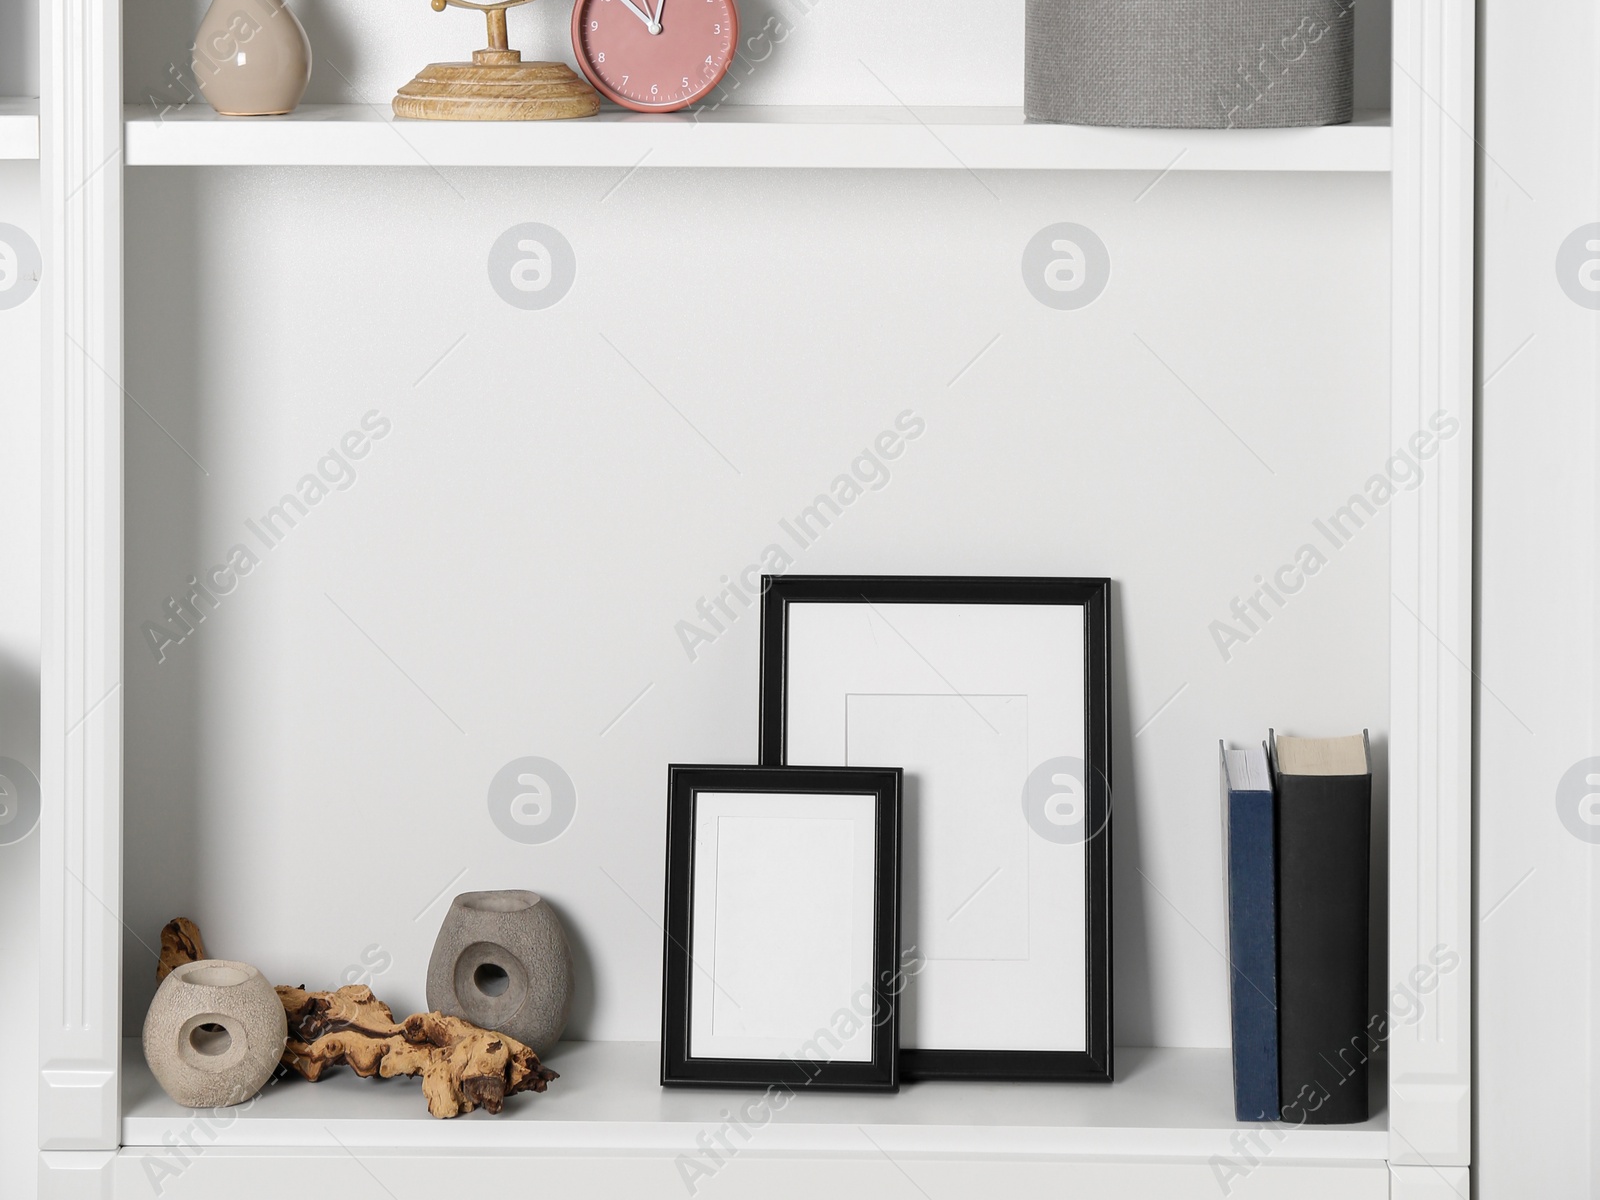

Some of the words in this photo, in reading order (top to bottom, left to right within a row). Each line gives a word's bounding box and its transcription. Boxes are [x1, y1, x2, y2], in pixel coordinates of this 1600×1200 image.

[591, 21, 598, 31] 9
[714, 24, 720, 35] 3
[598, 52, 605, 63] 8
[705, 55, 712, 65] 4
[622, 76, 629, 86] 7
[682, 77, 688, 88] 5
[651, 84, 658, 95] 6
